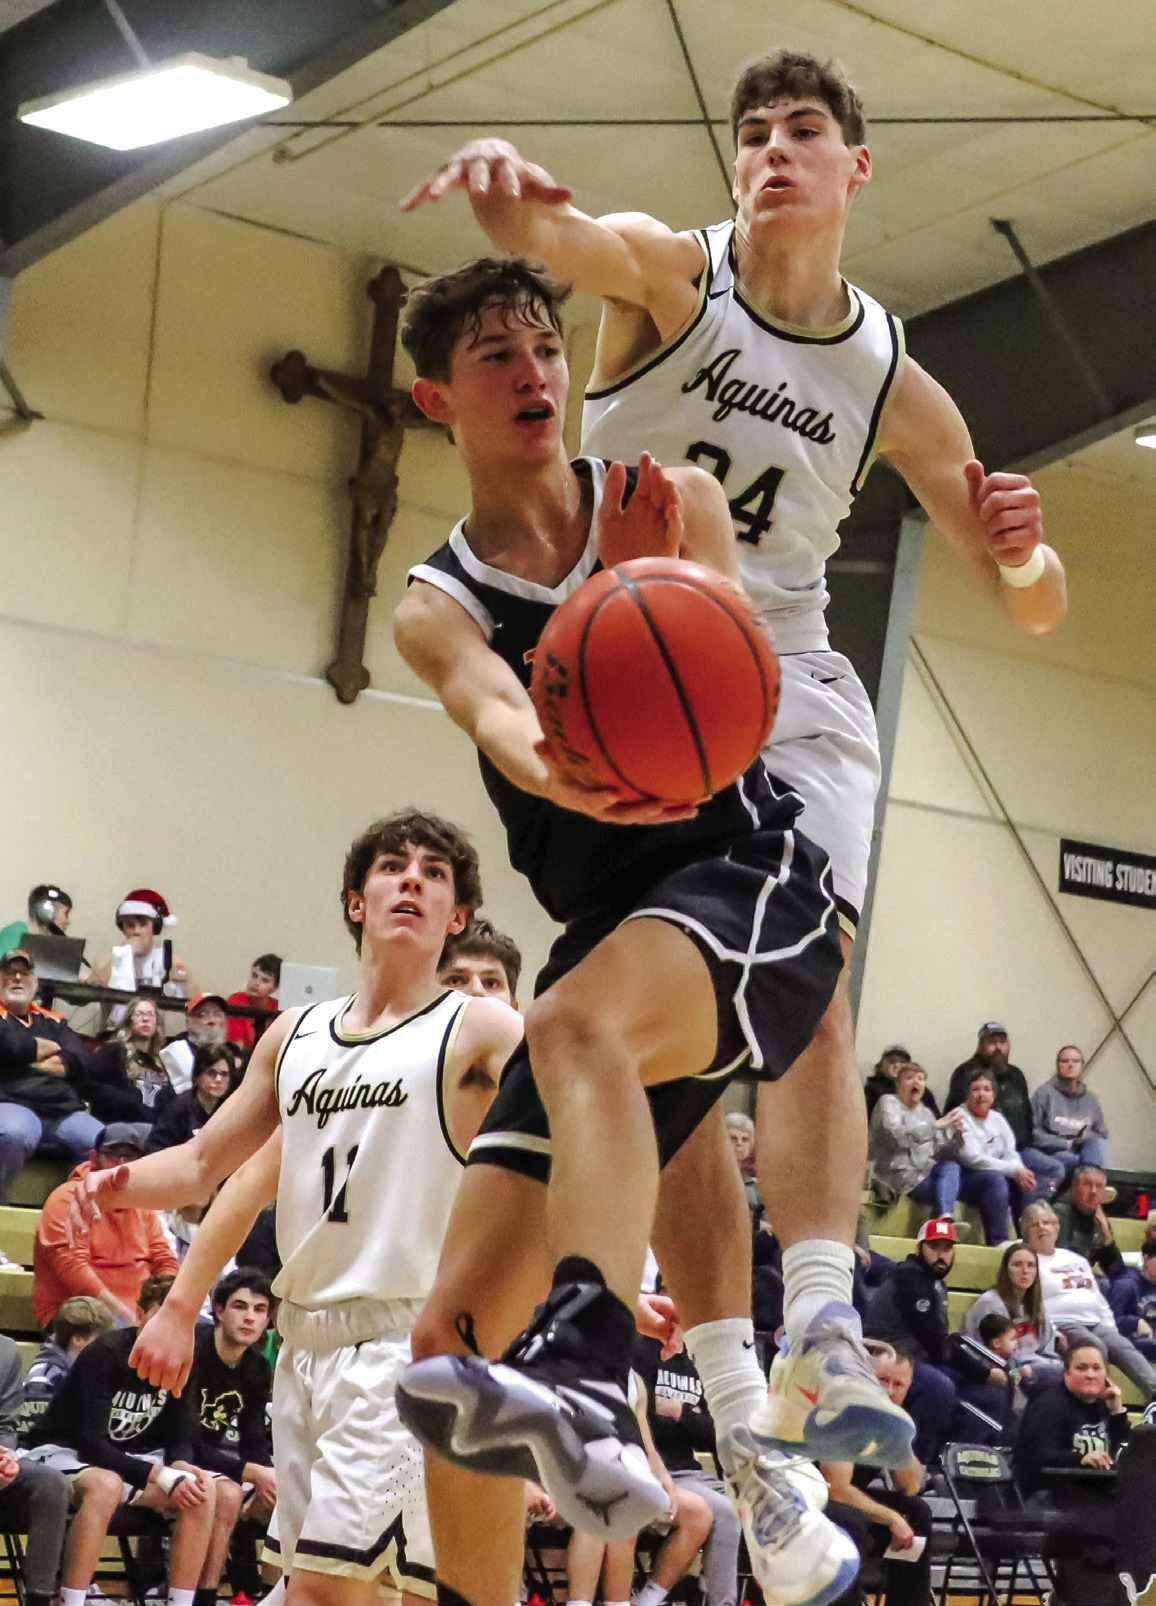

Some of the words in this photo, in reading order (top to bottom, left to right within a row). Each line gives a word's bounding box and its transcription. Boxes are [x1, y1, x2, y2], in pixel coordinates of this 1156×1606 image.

[681, 349, 836, 444] Aquinas
[1063, 853, 1113, 888] VISITING
[287, 1068, 408, 1129] Aquinas
[321, 1143, 360, 1223] 11
